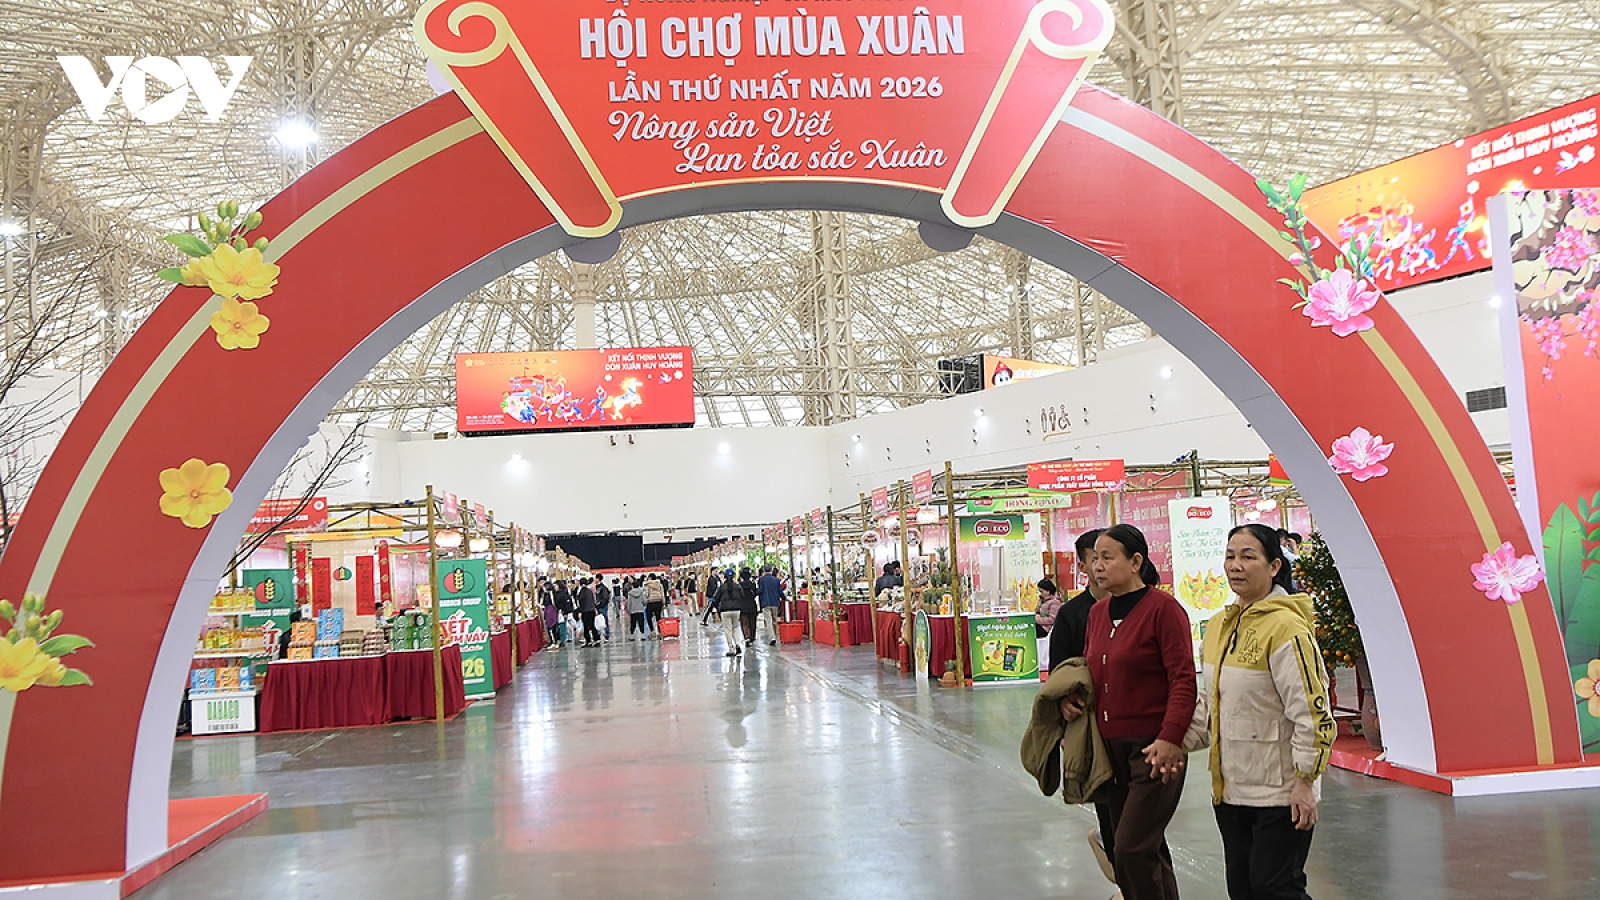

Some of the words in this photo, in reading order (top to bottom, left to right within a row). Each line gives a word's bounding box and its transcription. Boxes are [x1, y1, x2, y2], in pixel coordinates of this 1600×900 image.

[579, 9, 648, 67] HỘI
[661, 12, 742, 67] CHỢ
[755, 7, 846, 56] MÙA
[856, 6, 965, 55] XUÂN
[608, 69, 661, 102] LẦN
[668, 73, 723, 101] THỨ
[729, 69, 801, 100] NHẤT
[809, 72, 872, 99] NĂM
[879, 76, 944, 98] 2026
[608, 110, 701, 150] Nông
[705, 112, 760, 139] sản
[763, 107, 834, 143] Việt
[675, 142, 746, 174] Lan
[751, 143, 803, 171] tỏa
[807, 138, 857, 170] sắc
[860, 139, 948, 170] Xuân
